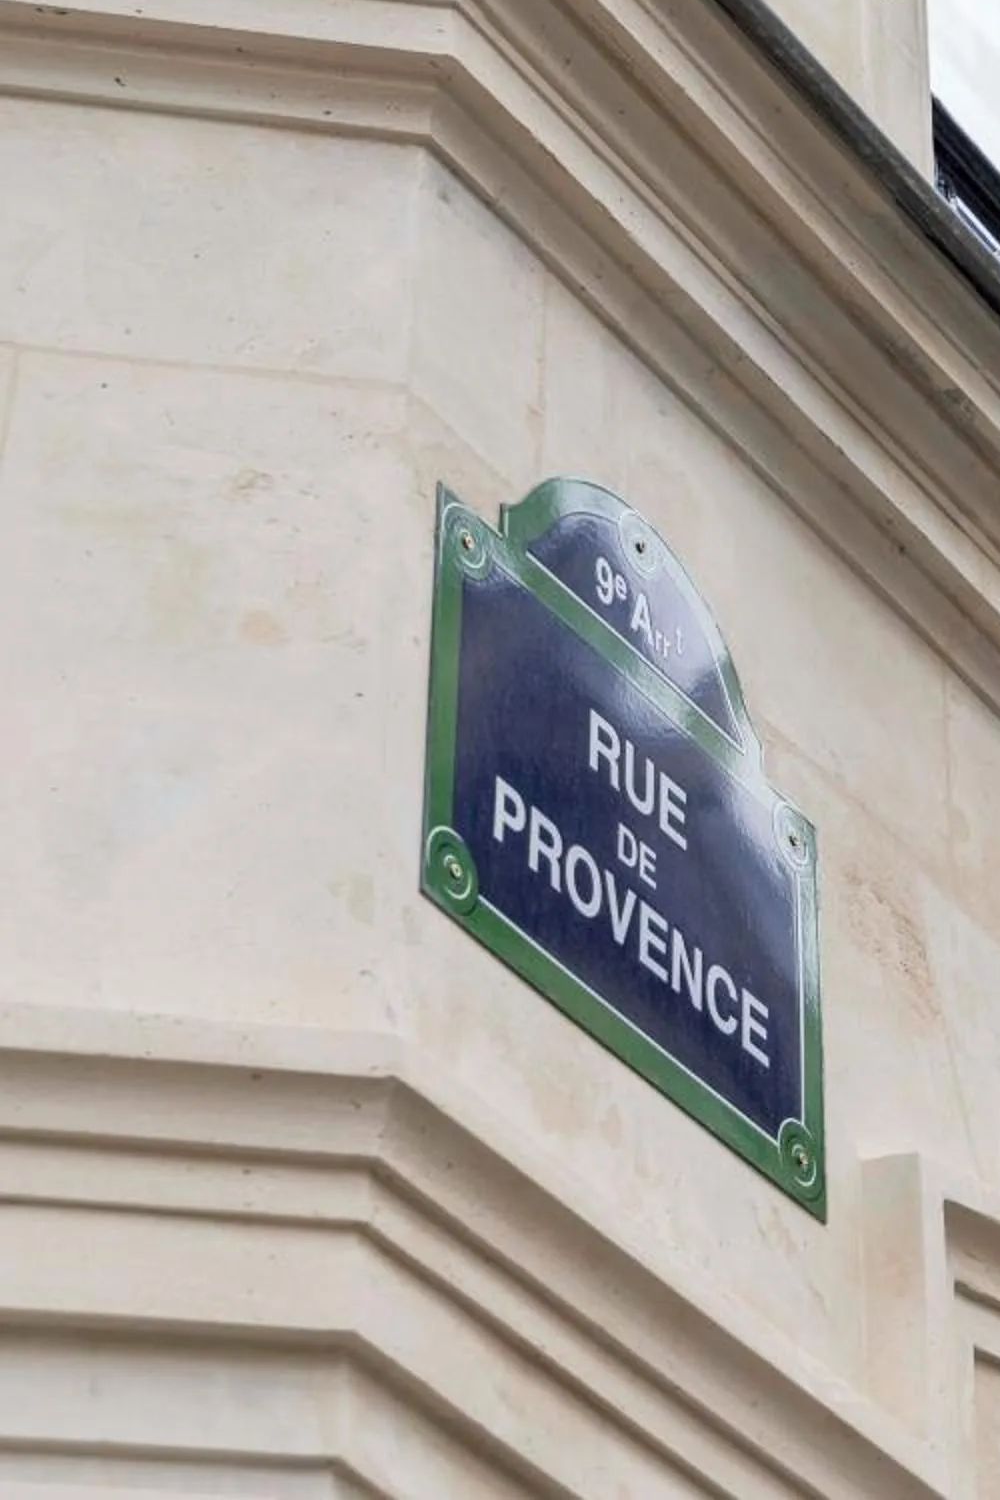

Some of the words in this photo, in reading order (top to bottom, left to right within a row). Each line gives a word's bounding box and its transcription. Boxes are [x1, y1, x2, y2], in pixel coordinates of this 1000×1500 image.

[588, 709, 688, 850] RUE
[491, 776, 770, 1068] PROVENCE
[616, 822, 658, 890] DE
